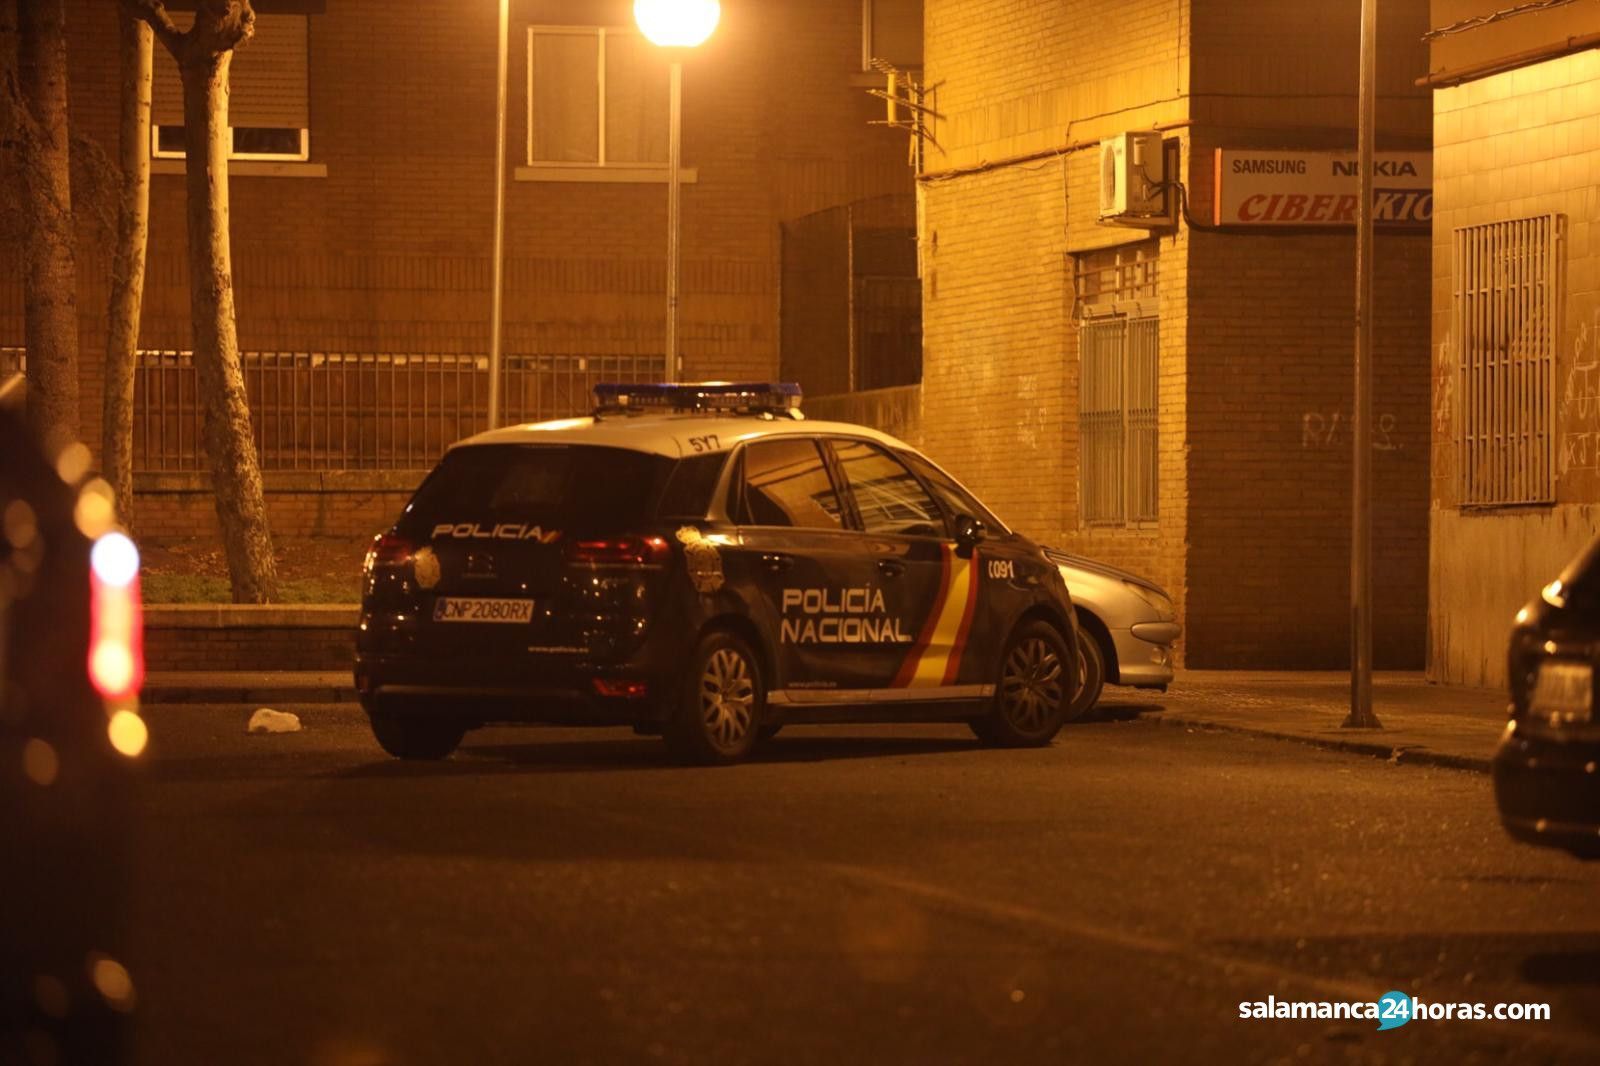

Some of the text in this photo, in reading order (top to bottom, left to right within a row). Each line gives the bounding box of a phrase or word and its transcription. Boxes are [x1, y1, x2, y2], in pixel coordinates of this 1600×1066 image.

[1232, 159, 1307, 175] SAMSUNG
[1332, 161, 1417, 176] NKIA
[1237, 194, 1358, 222] CIBER
[688, 434, 720, 452] 5Y7
[780, 618, 913, 643] NACIONAL
